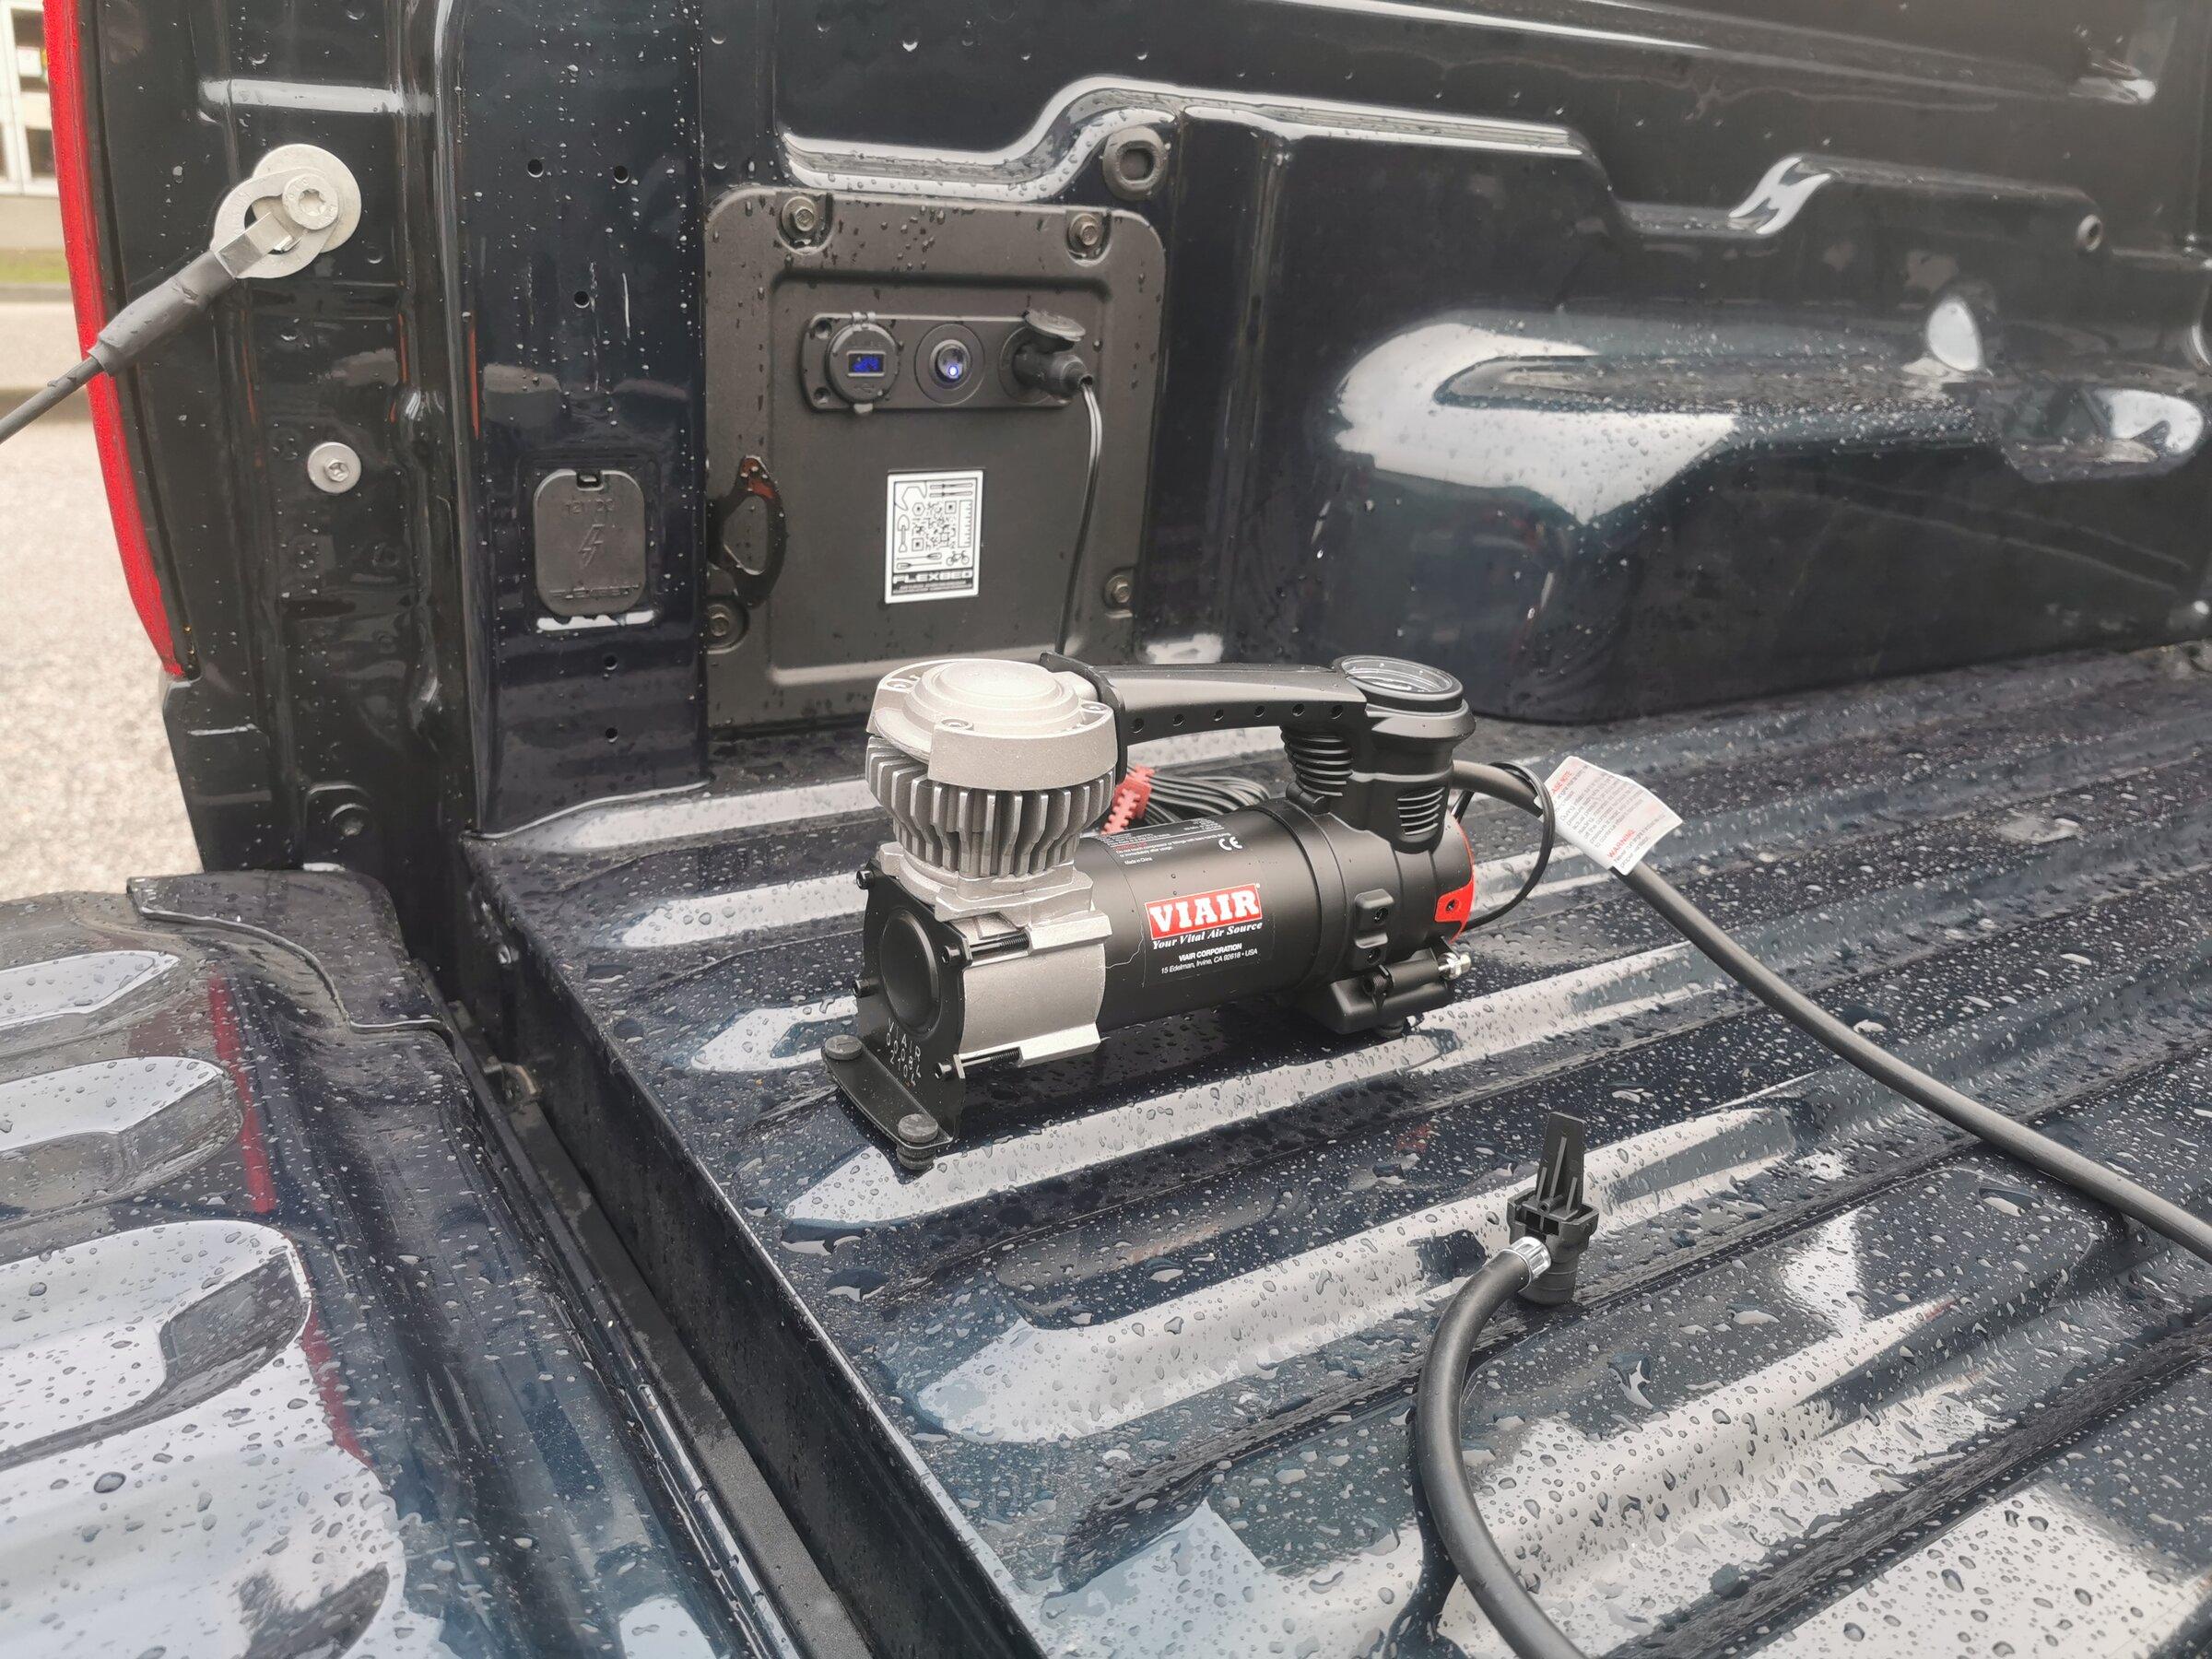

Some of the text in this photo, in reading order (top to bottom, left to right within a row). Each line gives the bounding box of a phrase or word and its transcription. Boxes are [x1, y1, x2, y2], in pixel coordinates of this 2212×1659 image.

[892, 569, 973, 584] FLEXBED
[1218, 836, 1243, 851] CE
[1606, 829, 1636, 858] WARNING
[1148, 889, 1260, 932] VIAIR
[1152, 922, 1263, 949] Your Vital Air Source
[1169, 961, 1195, 973] Edelman,
[1213, 956, 1223, 964] CA
[1223, 951, 1241, 962] 92618
[1245, 947, 1258, 957] USA
[1179, 943, 1242, 962] VIAIR CORPORATION
